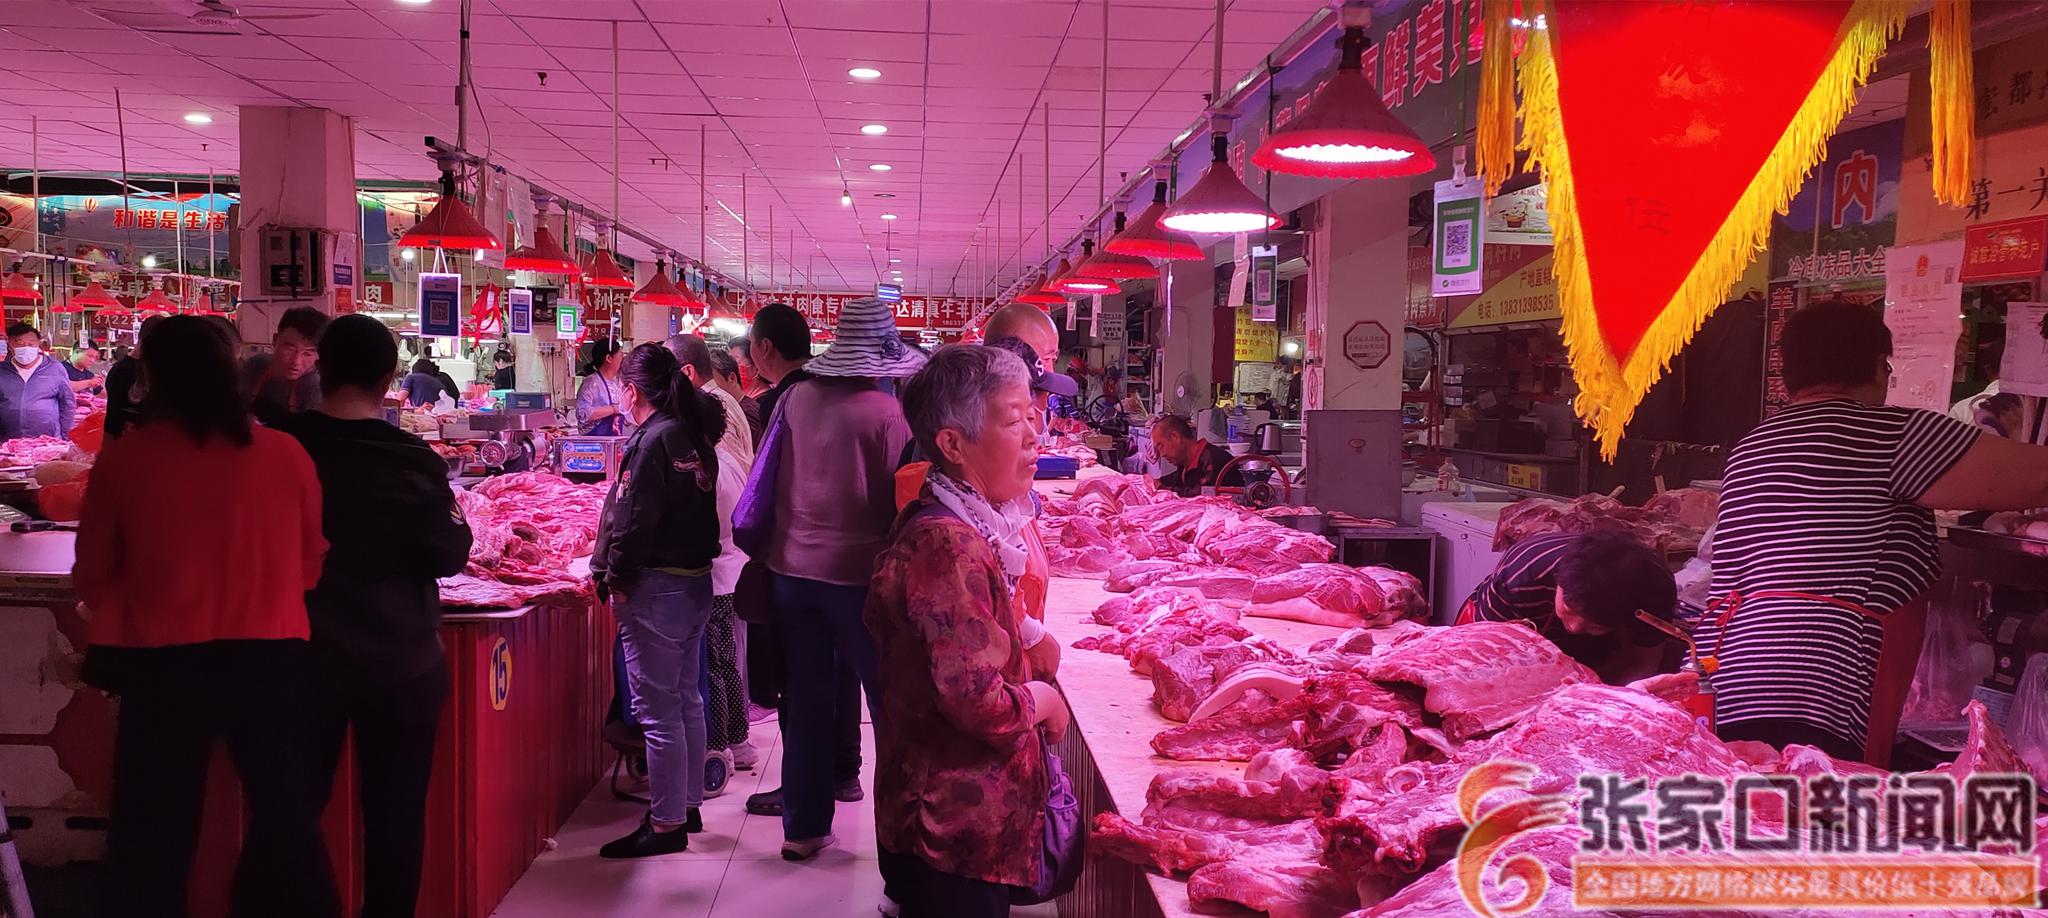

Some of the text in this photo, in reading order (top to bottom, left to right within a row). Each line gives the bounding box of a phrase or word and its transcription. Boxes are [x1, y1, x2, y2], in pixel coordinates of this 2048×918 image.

[113, 208, 227, 232] 和谐是生活
[493, 642, 507, 705] 15
